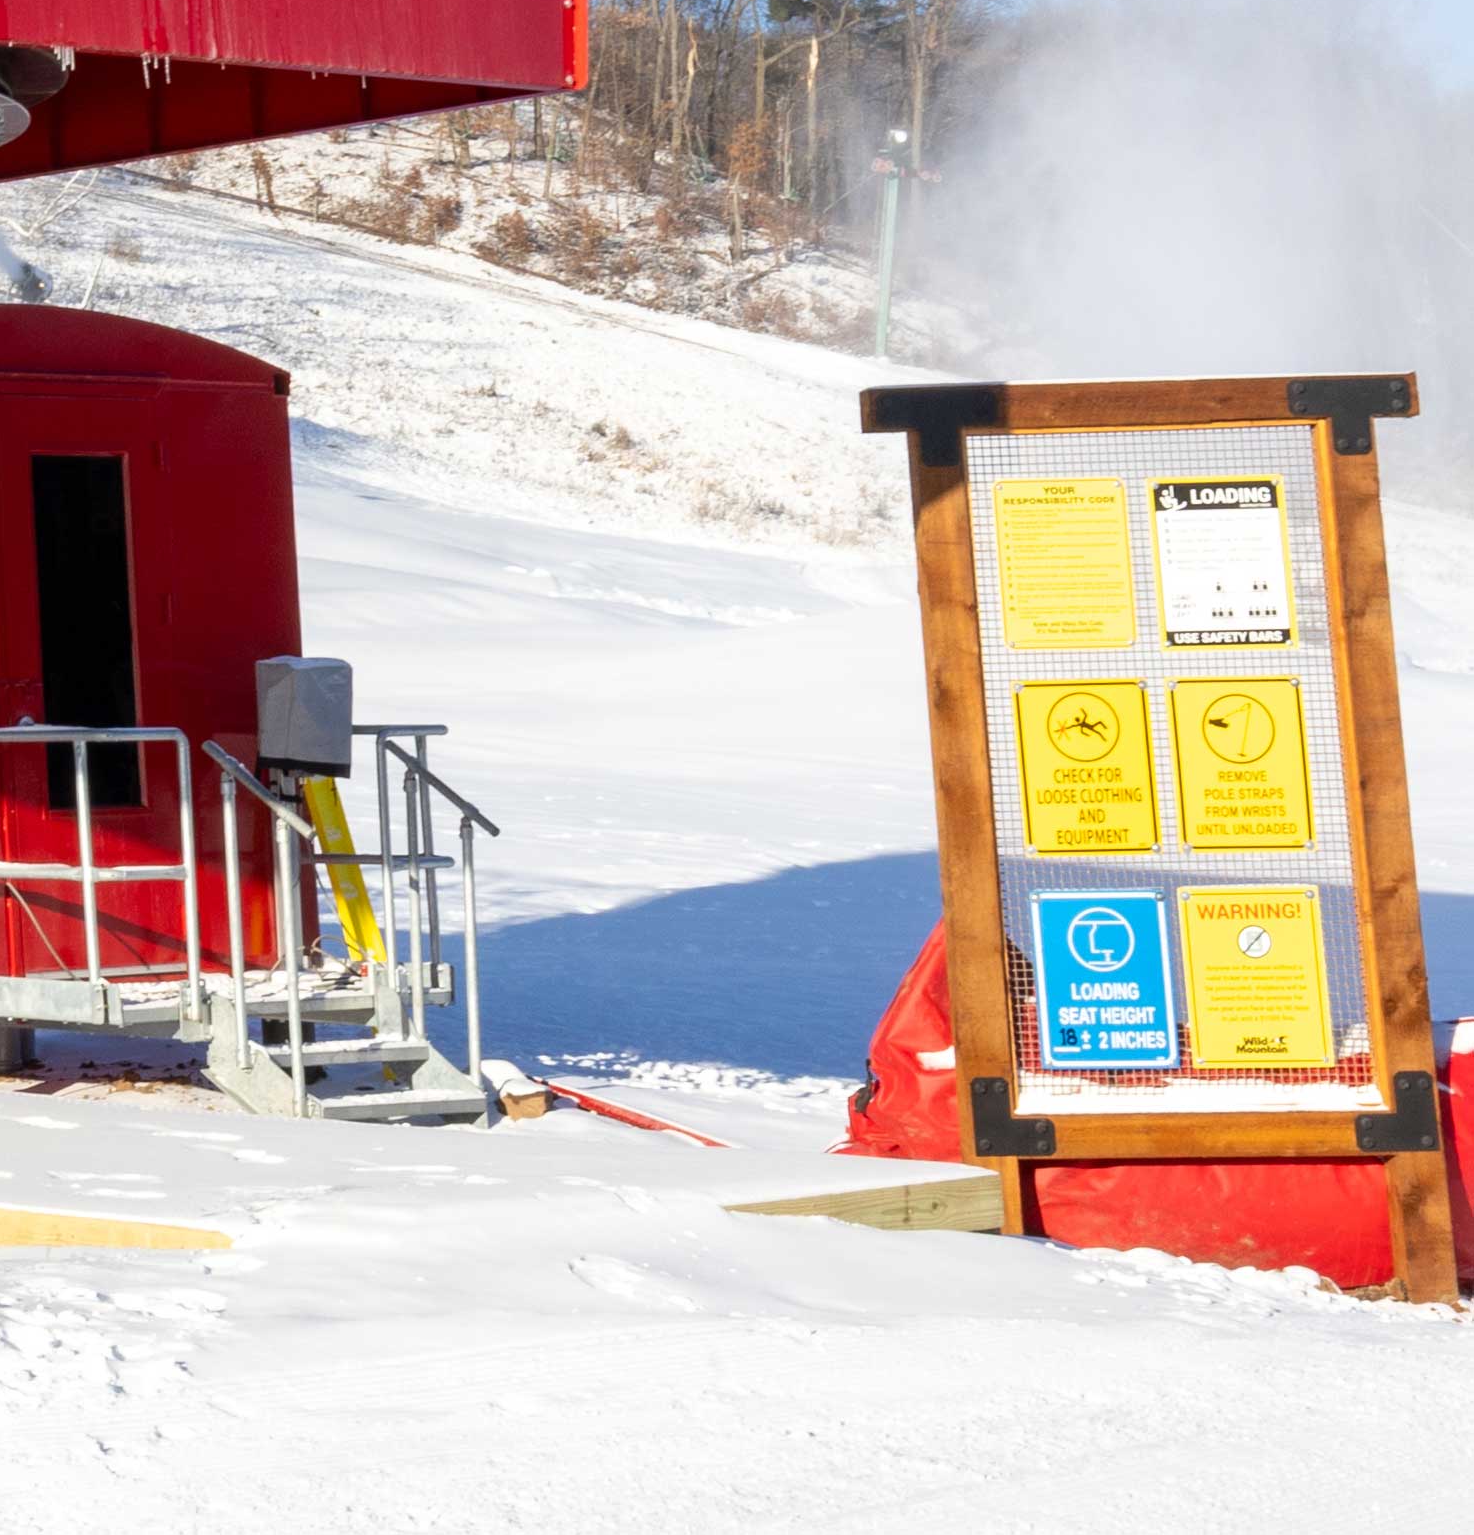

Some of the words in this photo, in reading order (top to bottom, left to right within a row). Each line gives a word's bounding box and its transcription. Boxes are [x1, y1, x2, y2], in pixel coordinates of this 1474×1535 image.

[1043, 486, 1075, 495] YOUR
[1189, 487, 1272, 505] LOADING
[1003, 497, 1085, 506] RESPONSIBILITY
[1088, 496, 1115, 505] CODE
[1173, 633, 1201, 645] USE
[1200, 632, 1248, 644] SAFETY
[1249, 630, 1284, 643] BARS
[1053, 768, 1094, 784] CHECK
[1097, 767, 1123, 783] FOR
[1217, 770, 1268, 782] REMOVE
[1036, 788, 1078, 805] LOOSE
[1080, 787, 1143, 804] CLOTHING
[1204, 788, 1236, 800] POLE
[1239, 787, 1285, 800] STRAPS
[1078, 808, 1106, 824] AND
[1205, 806, 1239, 817] FROM
[1242, 805, 1287, 817] WRISTS
[1056, 828, 1130, 846] EQUIPMENT
[1196, 824, 1229, 836] UNTIL
[1233, 823, 1298, 835] UNLOADED
[1197, 903, 1301, 920] WARNING!
[1070, 982, 1141, 1001] LOADING
[1058, 1006, 1097, 1025] SEAT
[1100, 1006, 1156, 1025] HEIGHT
[1059, 1027, 1078, 1046] 18
[1098, 1030, 1109, 1050] 2
[1110, 1030, 1167, 1049] INCHES
[1243, 1037, 1268, 1046] Wild
[1236, 1045, 1288, 1054] Mountain
